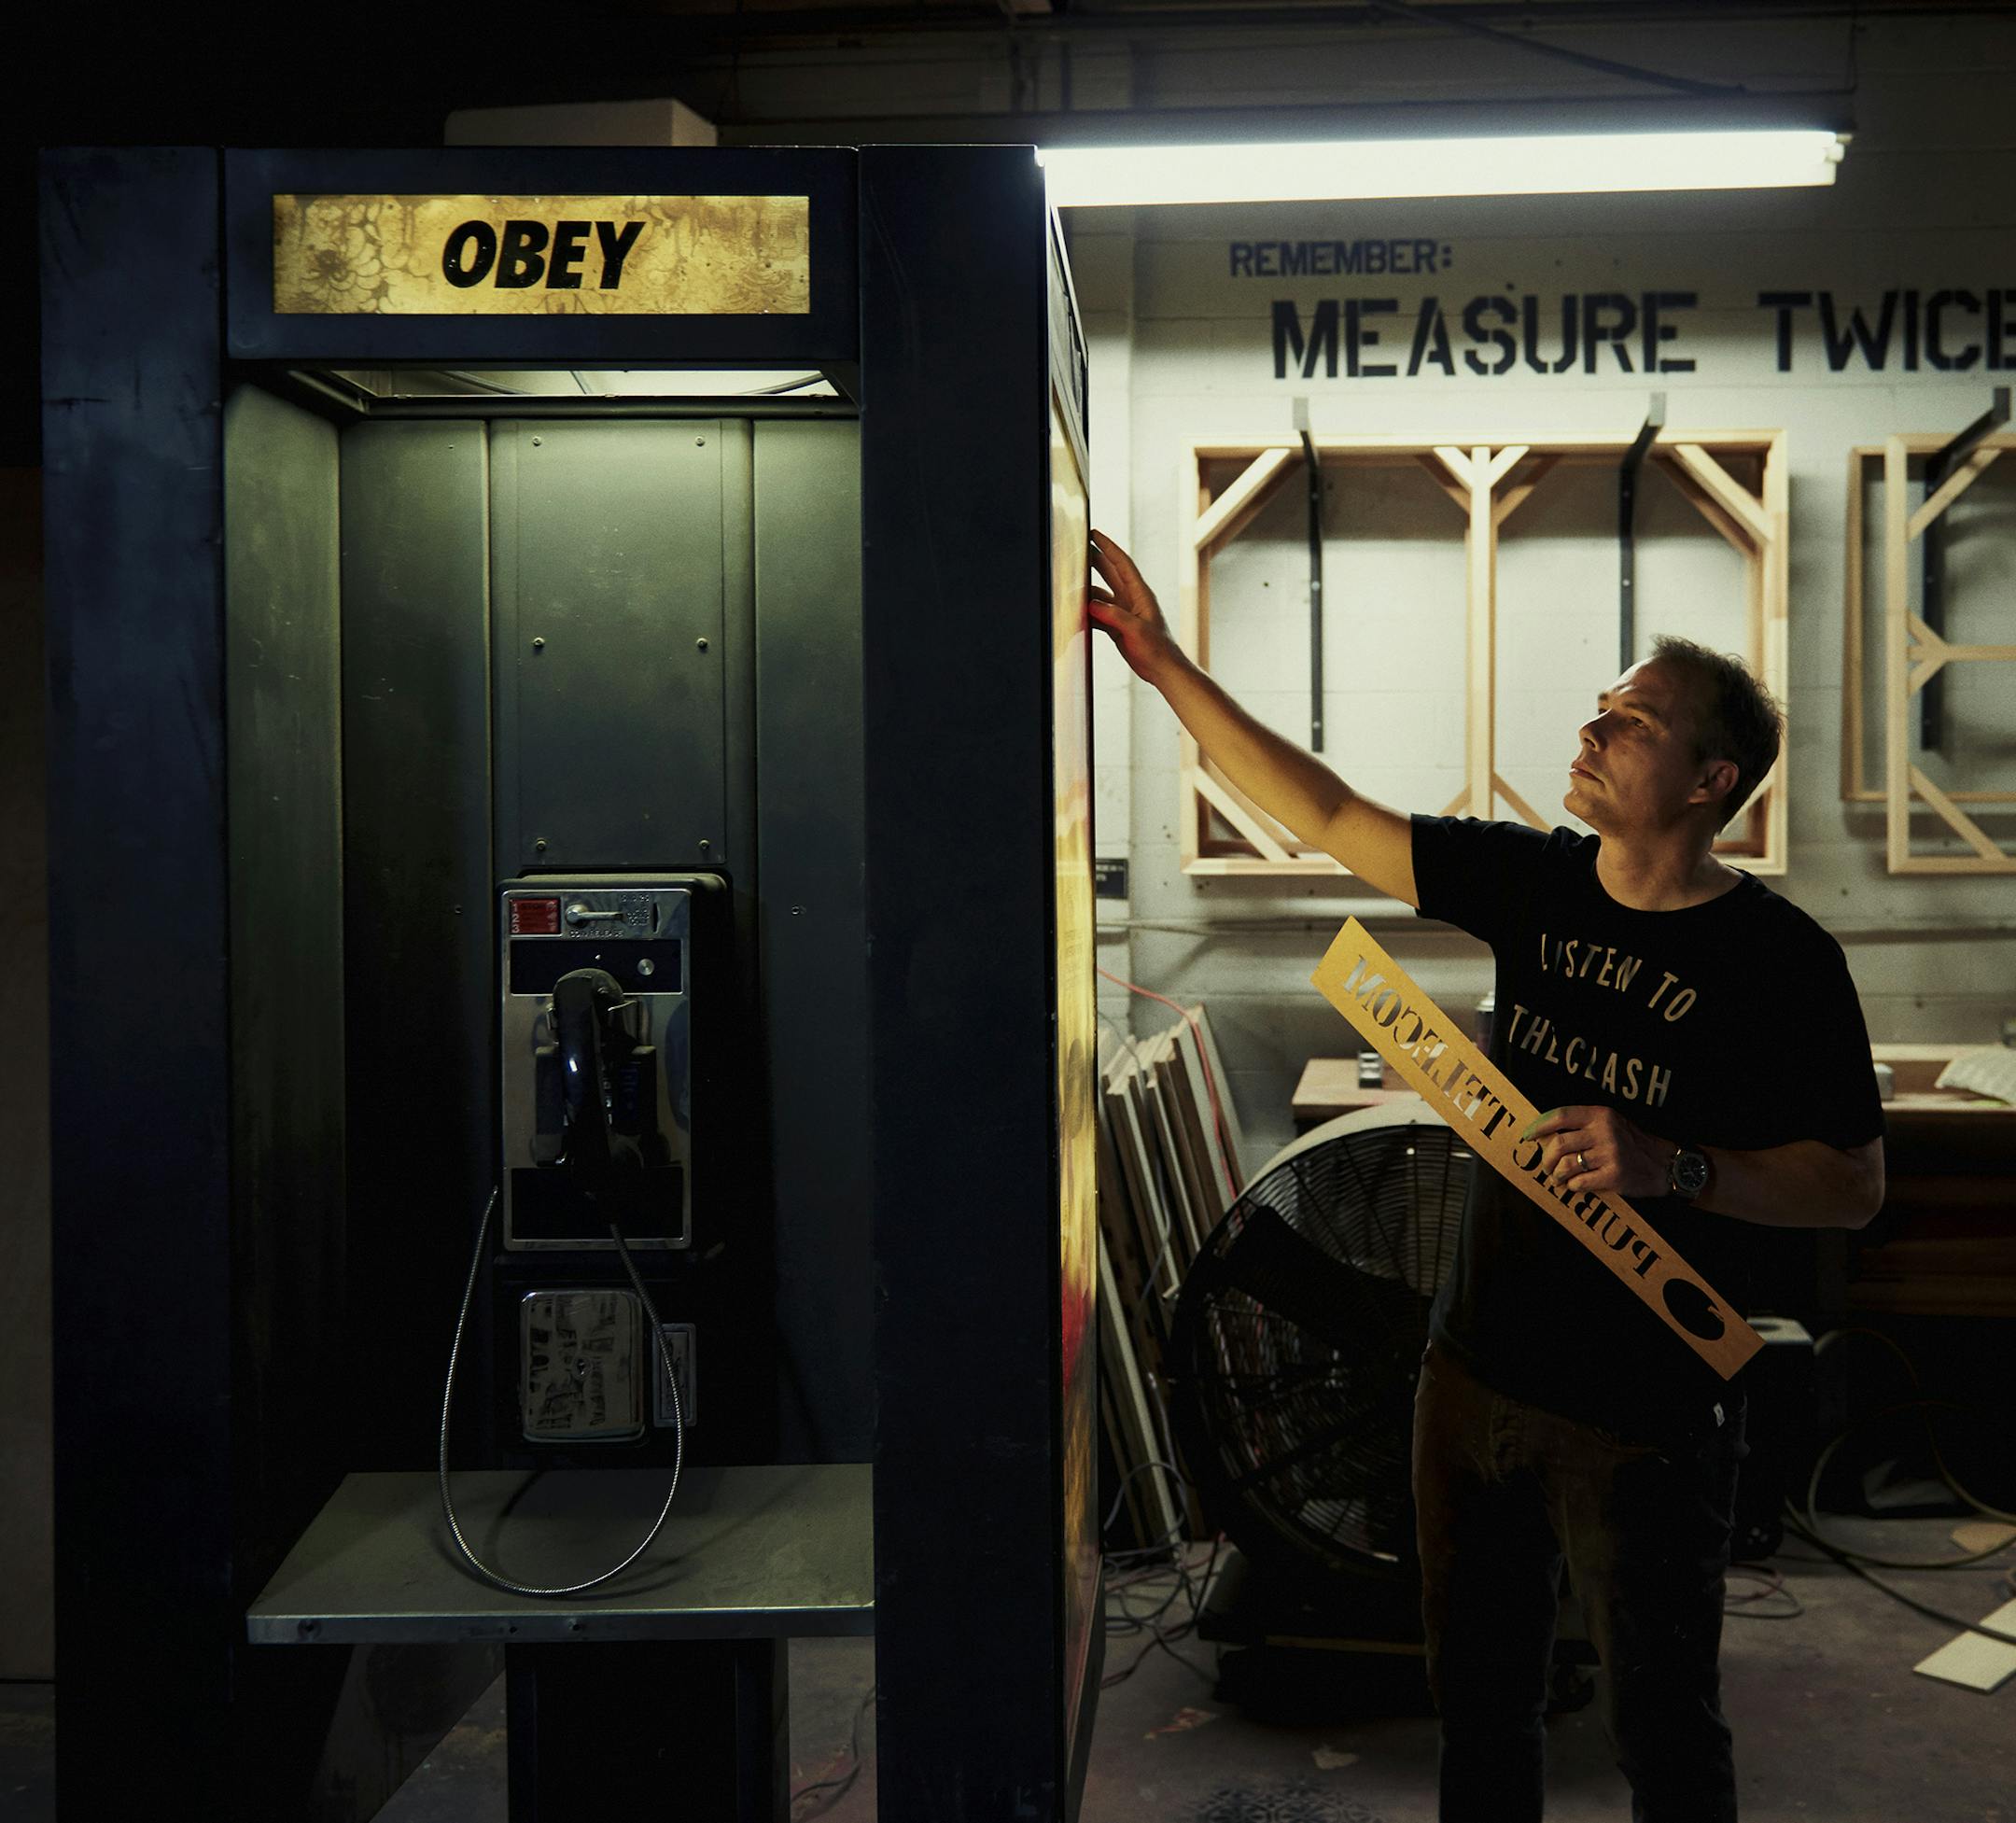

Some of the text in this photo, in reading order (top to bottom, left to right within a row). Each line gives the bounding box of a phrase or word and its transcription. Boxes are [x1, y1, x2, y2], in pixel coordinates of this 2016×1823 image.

[442, 220, 645, 289] OBEY
[1229, 239, 1452, 277] REMEMBER:
[1272, 289, 2016, 379] MEASURE TWICE
[1540, 933, 1698, 1022] LISTEN TO
